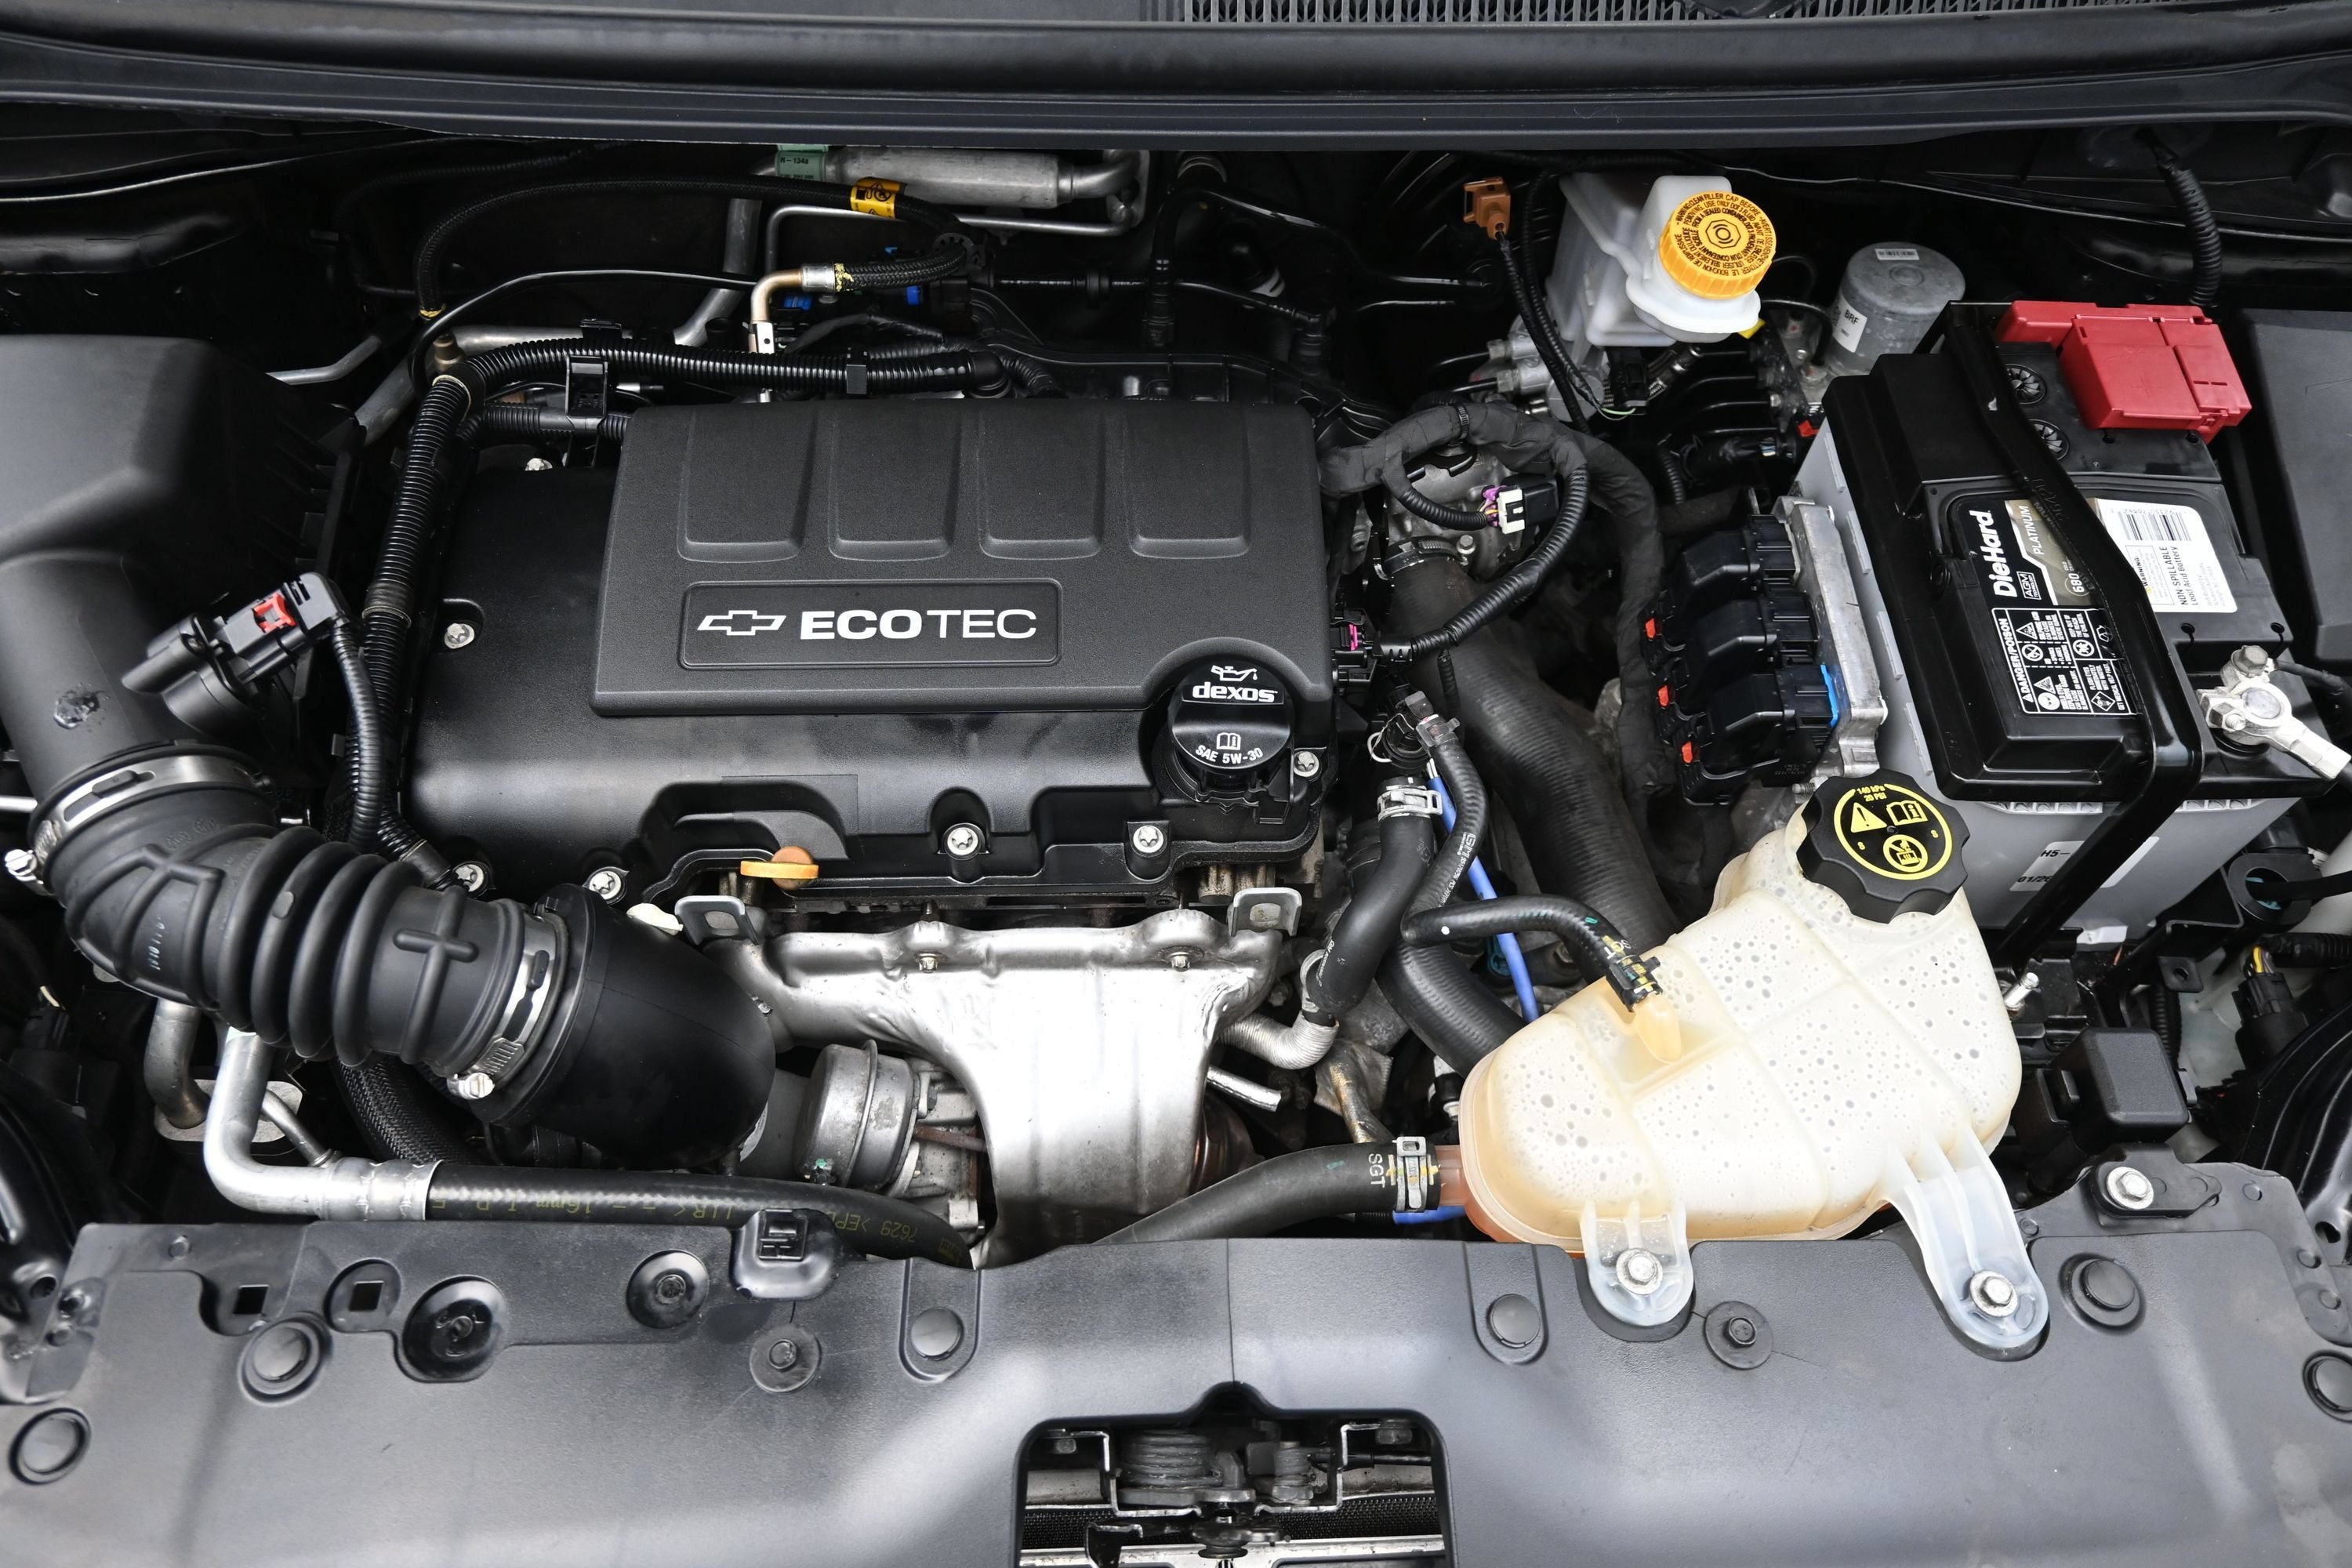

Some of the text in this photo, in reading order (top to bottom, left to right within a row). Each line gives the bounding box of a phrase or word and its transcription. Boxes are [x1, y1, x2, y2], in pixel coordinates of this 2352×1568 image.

[1726, 194, 1739, 203] CAP
[1739, 200, 1761, 216] BEFORE
[1741, 209, 1757, 221] FLUID
[1692, 258, 1703, 267] DE
[1700, 263, 1729, 276] BOUCHON
[1844, 310, 1860, 325] BRF
[2018, 505, 2045, 555] PLATINUM
[1969, 510, 2017, 597] DieHard
[2019, 573, 2033, 597] AGM
[2068, 573, 2085, 593] 680
[2169, 546, 2198, 604] Lead Acid Battery
[800, 609, 1037, 640] ECOTEC
[1997, 618, 2031, 692] DANGER/POISON
[1192, 681, 1277, 702] dexos
[1195, 745, 1264, 764] SAE 5W-30
[1857, 786, 1871, 795] 140
[1864, 793, 1875, 802] 20
[1461, 833, 1476, 858] GM
[1604, 939, 1632, 960] SGT
[1368, 1153, 1386, 1189] SGT
